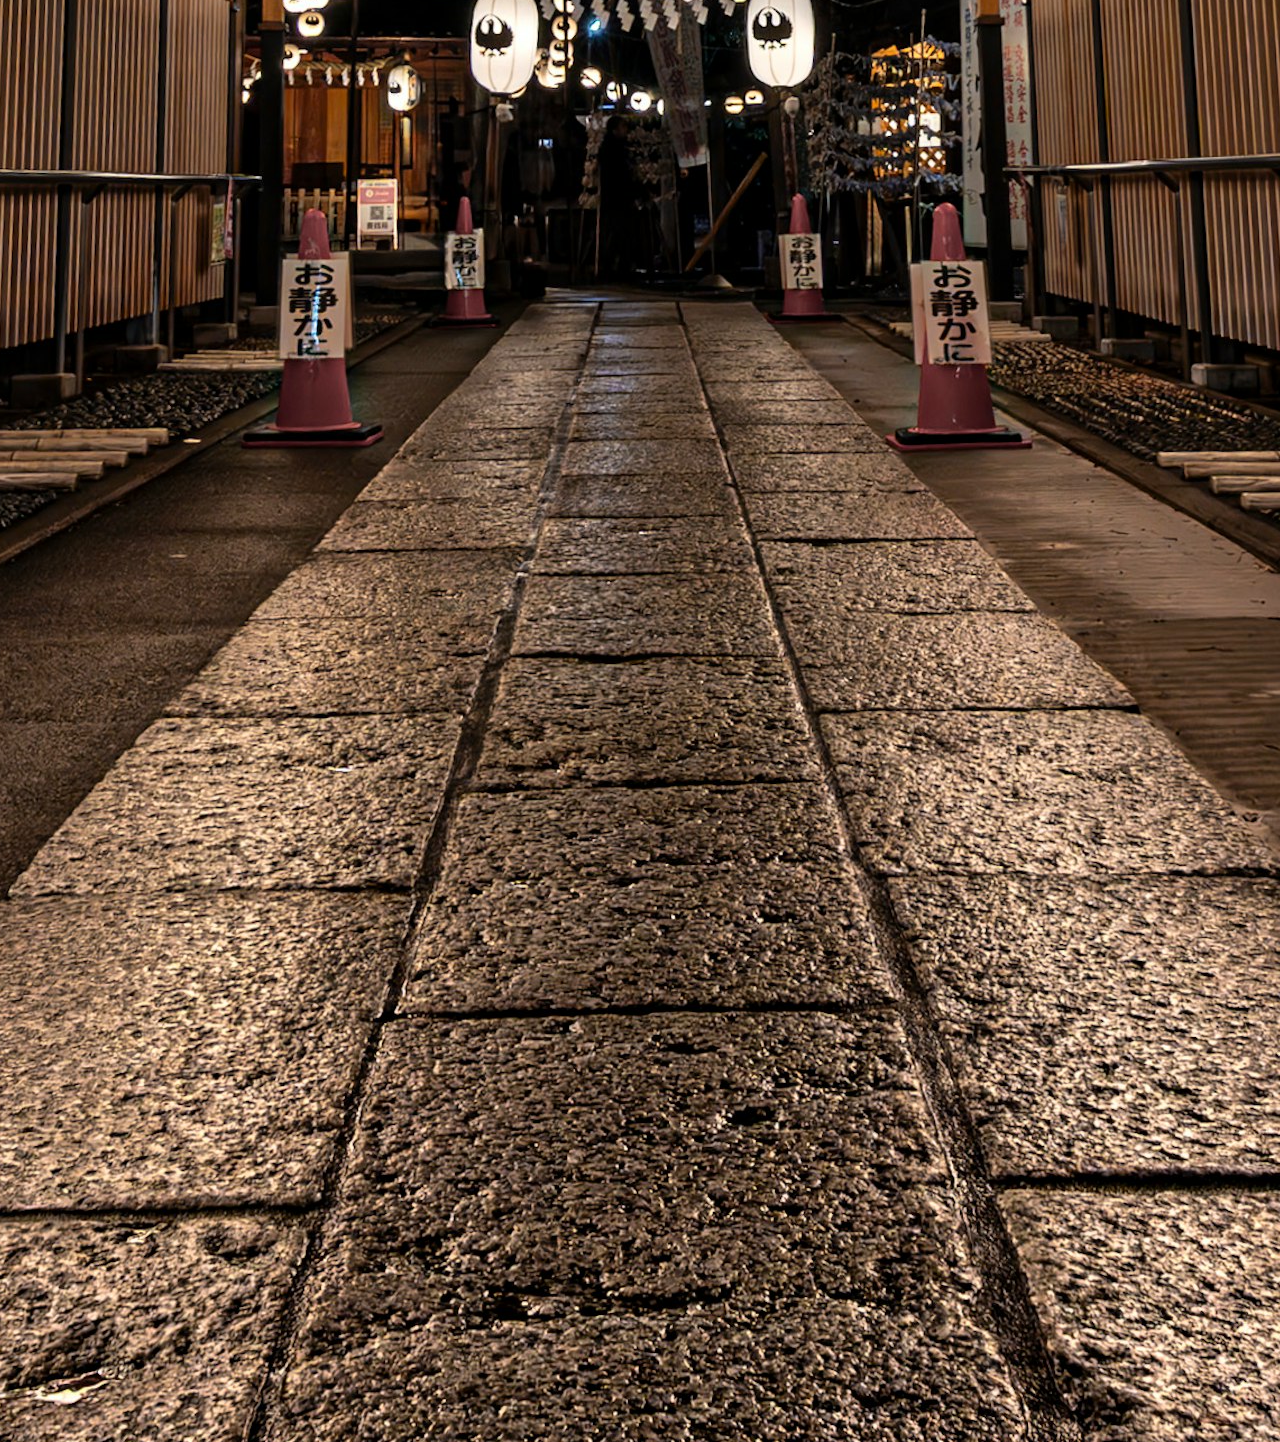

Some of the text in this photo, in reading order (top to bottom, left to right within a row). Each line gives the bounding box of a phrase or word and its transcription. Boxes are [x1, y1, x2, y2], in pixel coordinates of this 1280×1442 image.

[788, 236, 817, 289] お静かに
[288, 263, 338, 356] お静かに
[929, 265, 979, 363] お静かに
